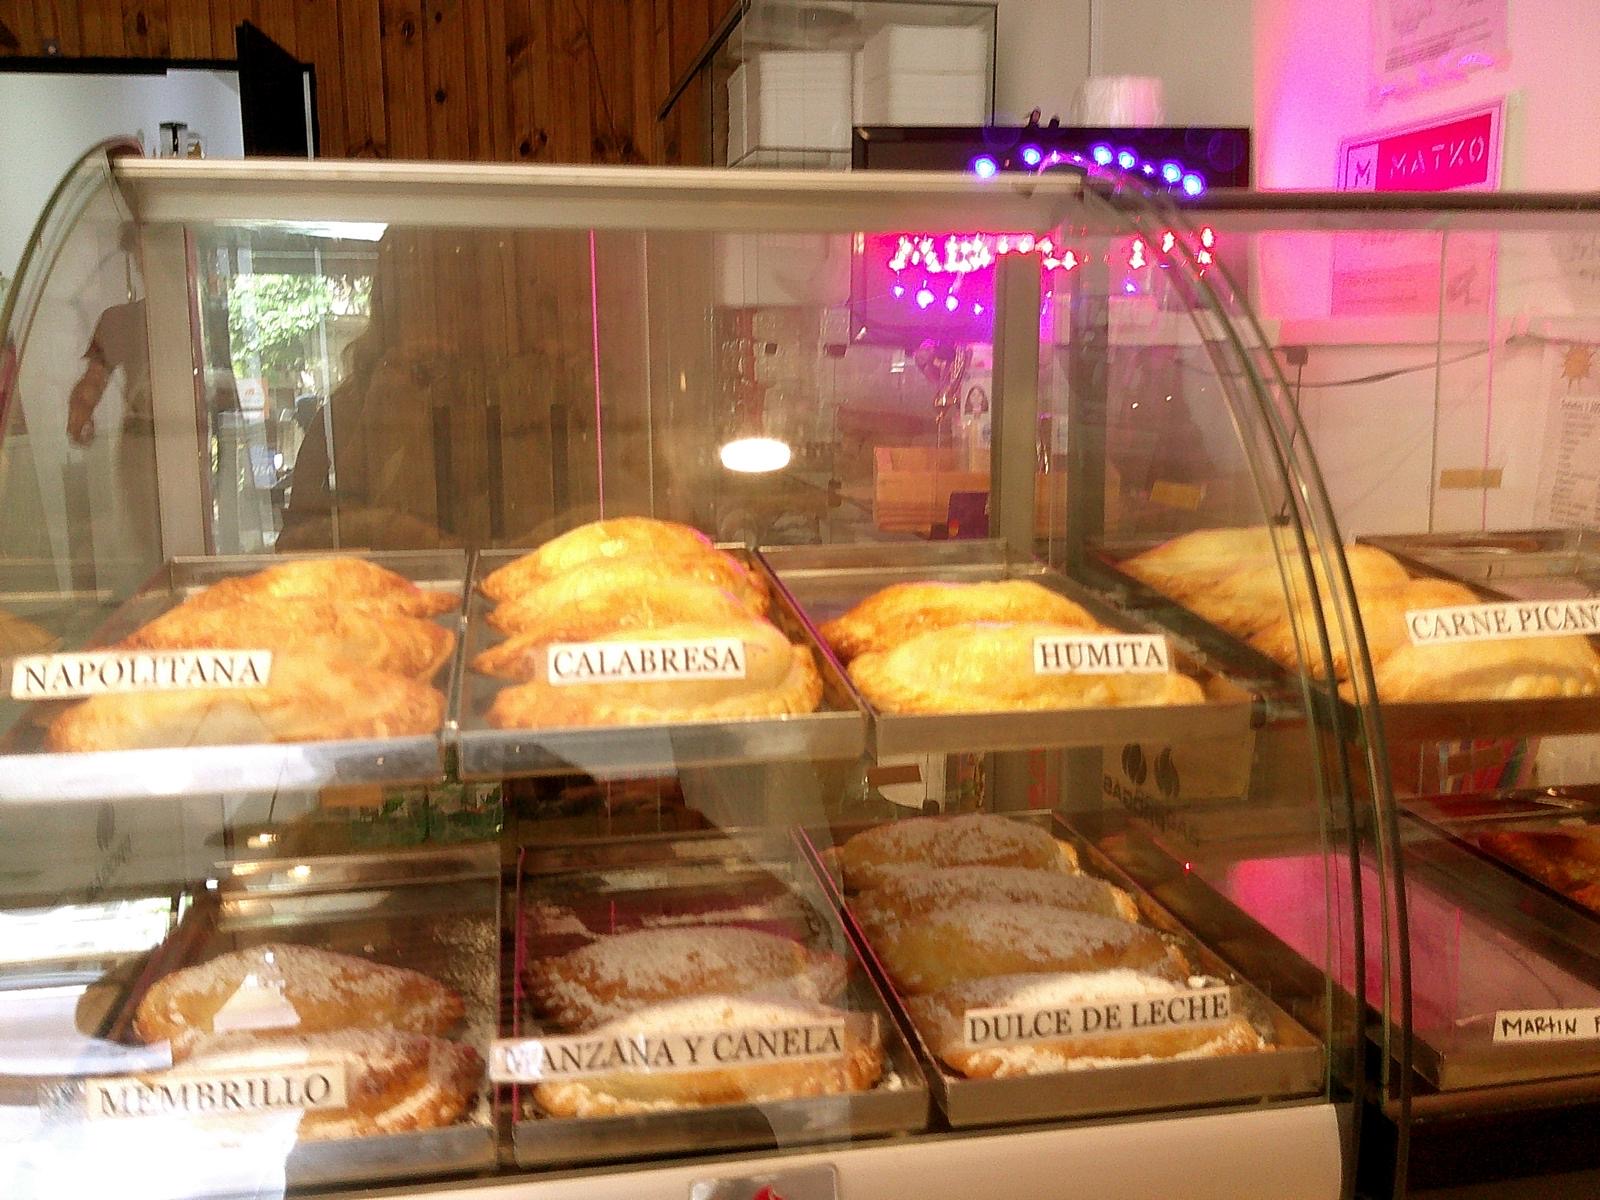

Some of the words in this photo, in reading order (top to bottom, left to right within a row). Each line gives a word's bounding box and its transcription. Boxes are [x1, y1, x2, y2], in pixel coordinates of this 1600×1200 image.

[1411, 608, 1511, 641] CARNE
[1518, 603, 1600, 634] PICAN
[23, 654, 265, 694] NAPOLITANA
[552, 643, 743, 678] CALABRESA
[1039, 639, 1165, 671] HUMITA
[968, 1009, 1073, 1044] DULCE
[1081, 1006, 1123, 1034] DE
[1129, 993, 1229, 1030] LECHE
[687, 1033, 708, 1064] Y
[714, 1024, 843, 1061] CANELA
[98, 1071, 332, 1117] MEMBRILLO
